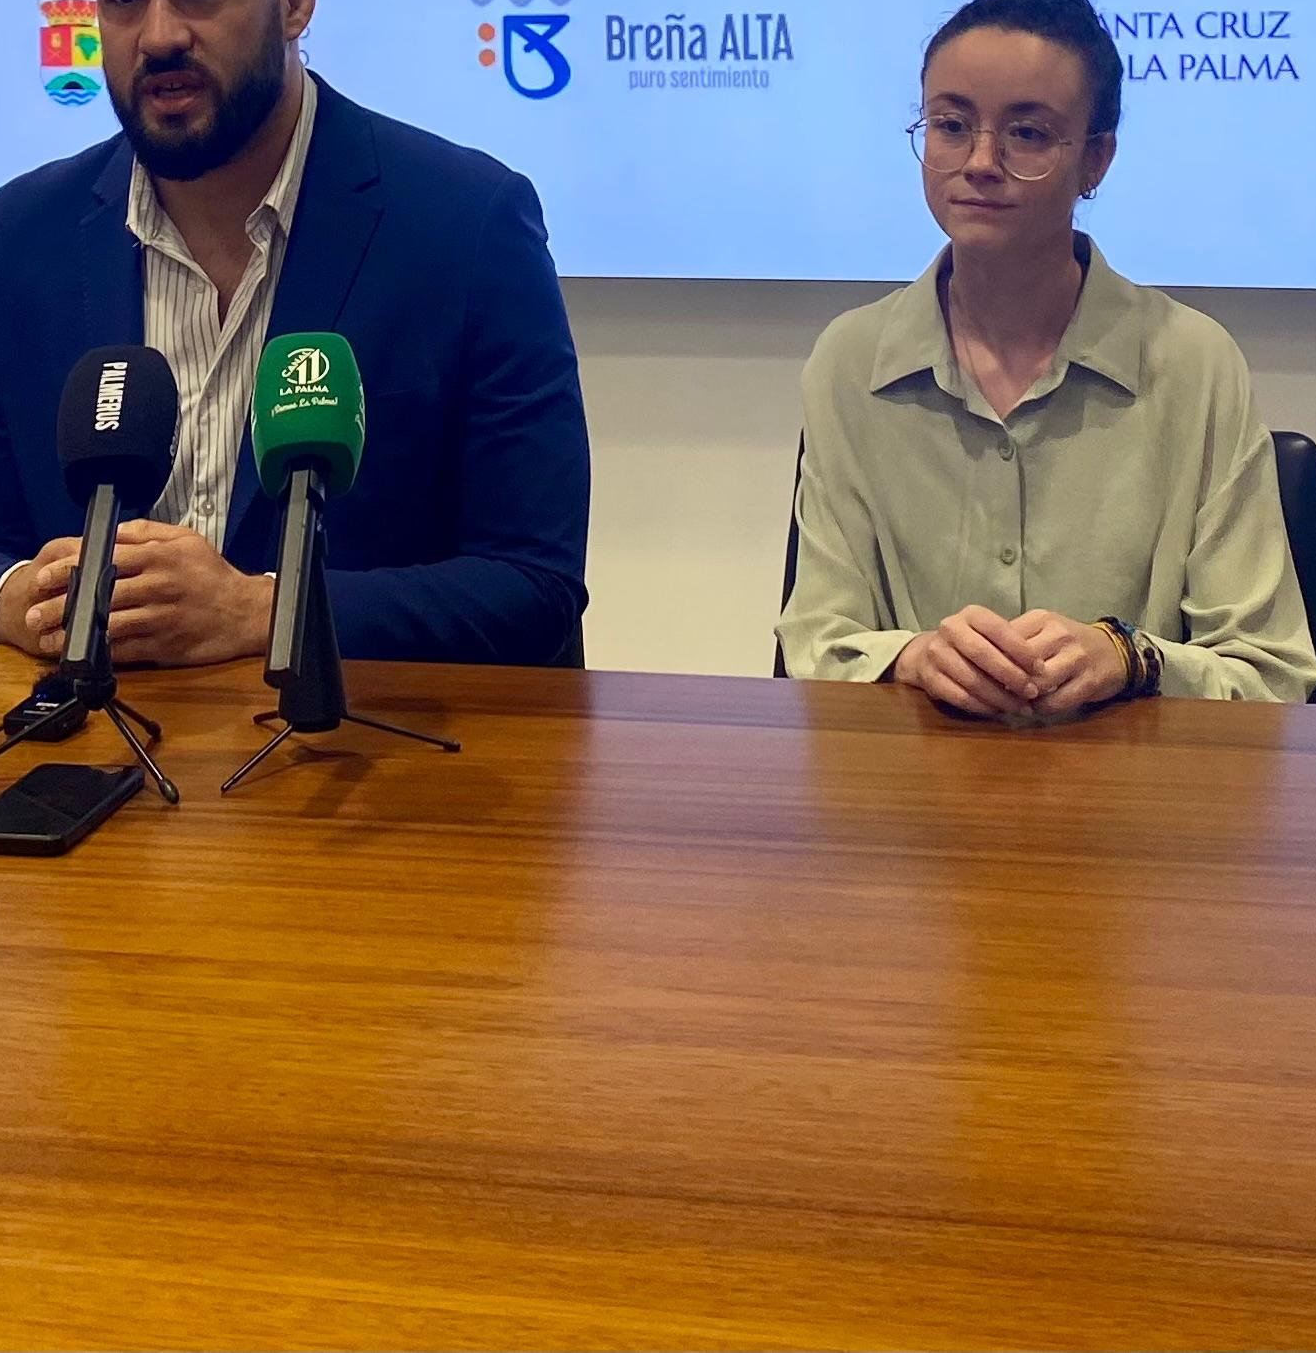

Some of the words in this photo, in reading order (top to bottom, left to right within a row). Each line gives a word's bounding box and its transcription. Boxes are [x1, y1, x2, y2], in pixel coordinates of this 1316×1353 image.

[606, 13, 707, 61] Breña
[720, 13, 794, 61] ALTA
[1196, 11, 1291, 39] CRUZ
[629, 69, 666, 90] puro
[670, 66, 770, 88] sentimiento
[1128, 54, 1167, 81] LA
[1179, 54, 1300, 81] PALMA
[279, 387, 293, 396] LA
[295, 385, 329, 394] PALMA
